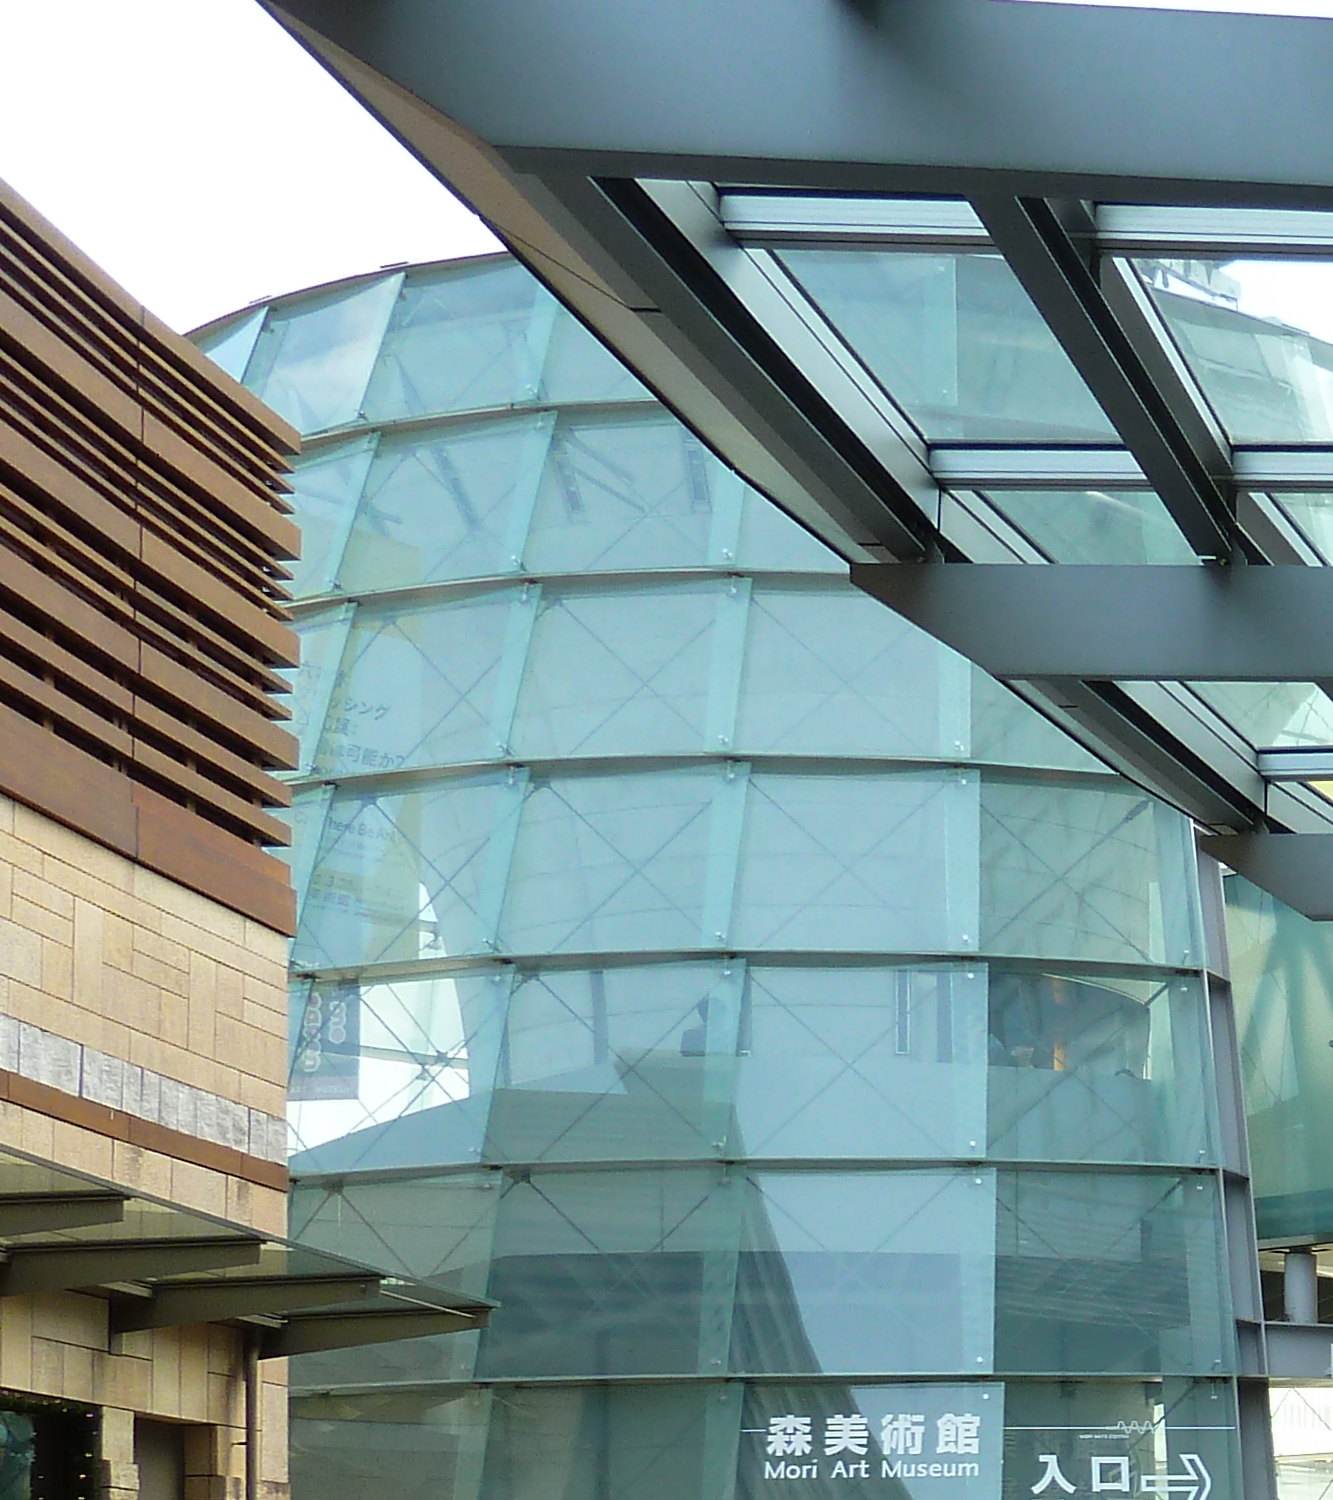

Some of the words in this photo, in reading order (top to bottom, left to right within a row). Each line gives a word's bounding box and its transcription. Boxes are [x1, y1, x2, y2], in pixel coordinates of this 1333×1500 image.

[766, 1413, 982, 1457] 森美術館
[764, 1459, 817, 1479] Mori
[831, 1459, 870, 1479] Art
[881, 1459, 979, 1479] Museum
[1031, 1454, 1130, 1494] 入口
